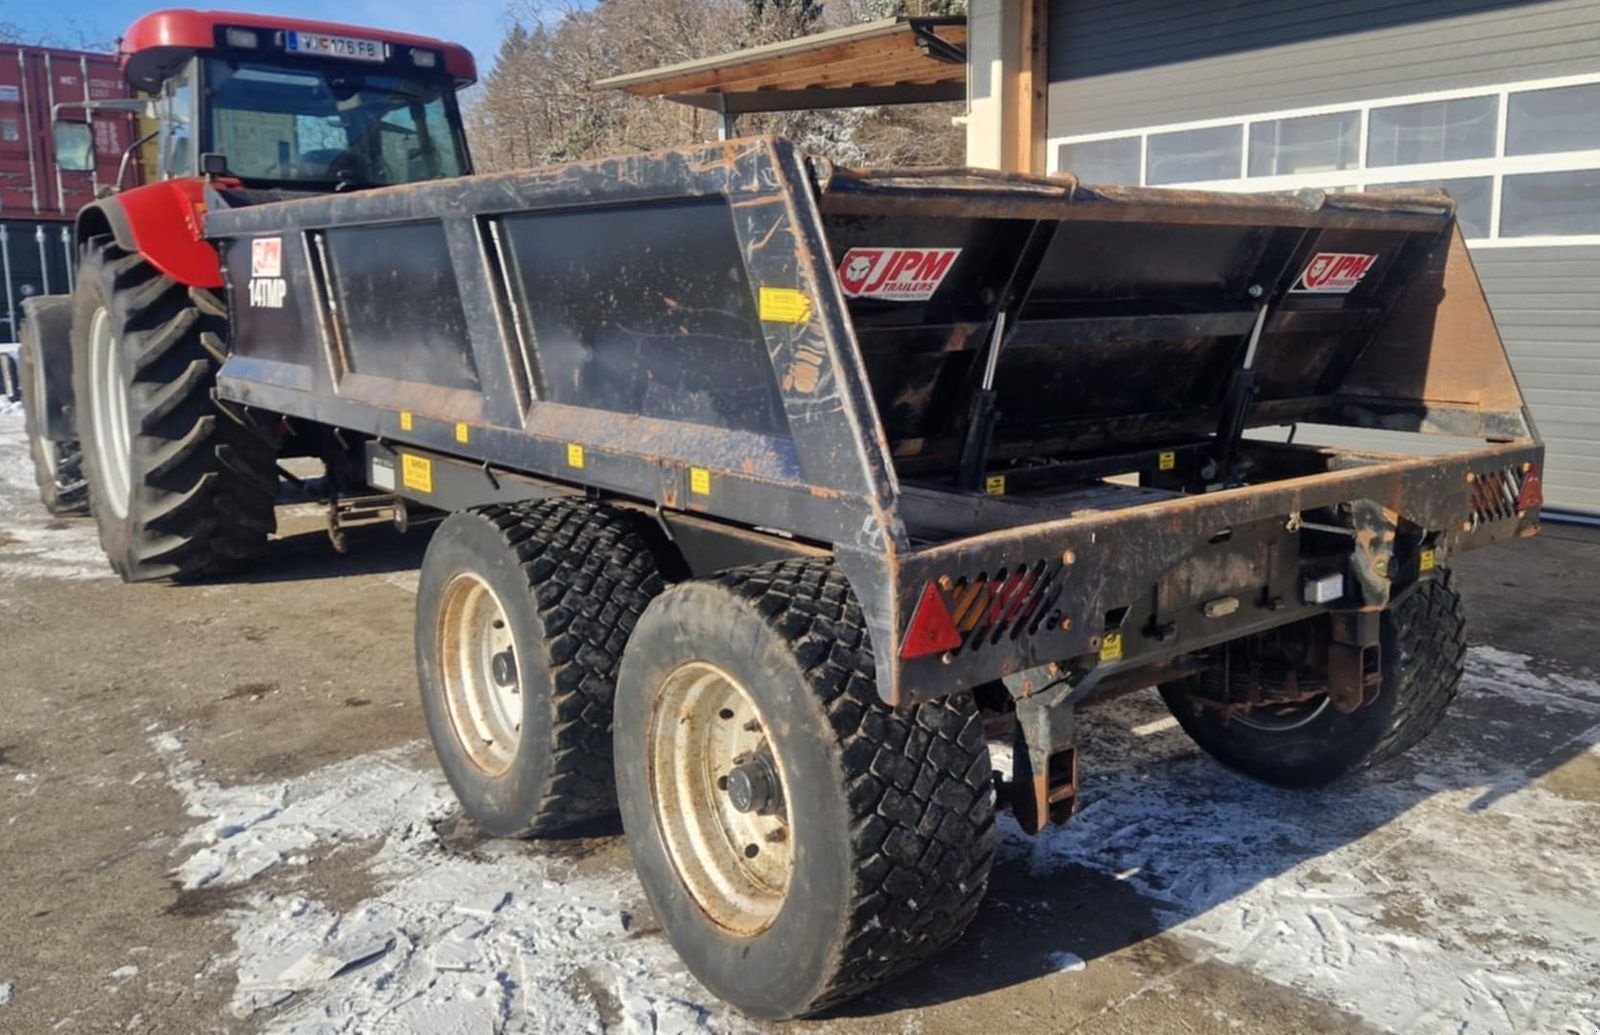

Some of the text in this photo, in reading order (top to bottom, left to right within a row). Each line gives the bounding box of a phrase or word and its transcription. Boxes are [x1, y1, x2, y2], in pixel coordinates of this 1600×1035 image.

[863, 251, 957, 293] JPM
[1316, 256, 1375, 286] JPM
[248, 278, 287, 308] 14TMP
[882, 282, 935, 293] TRAILERS
